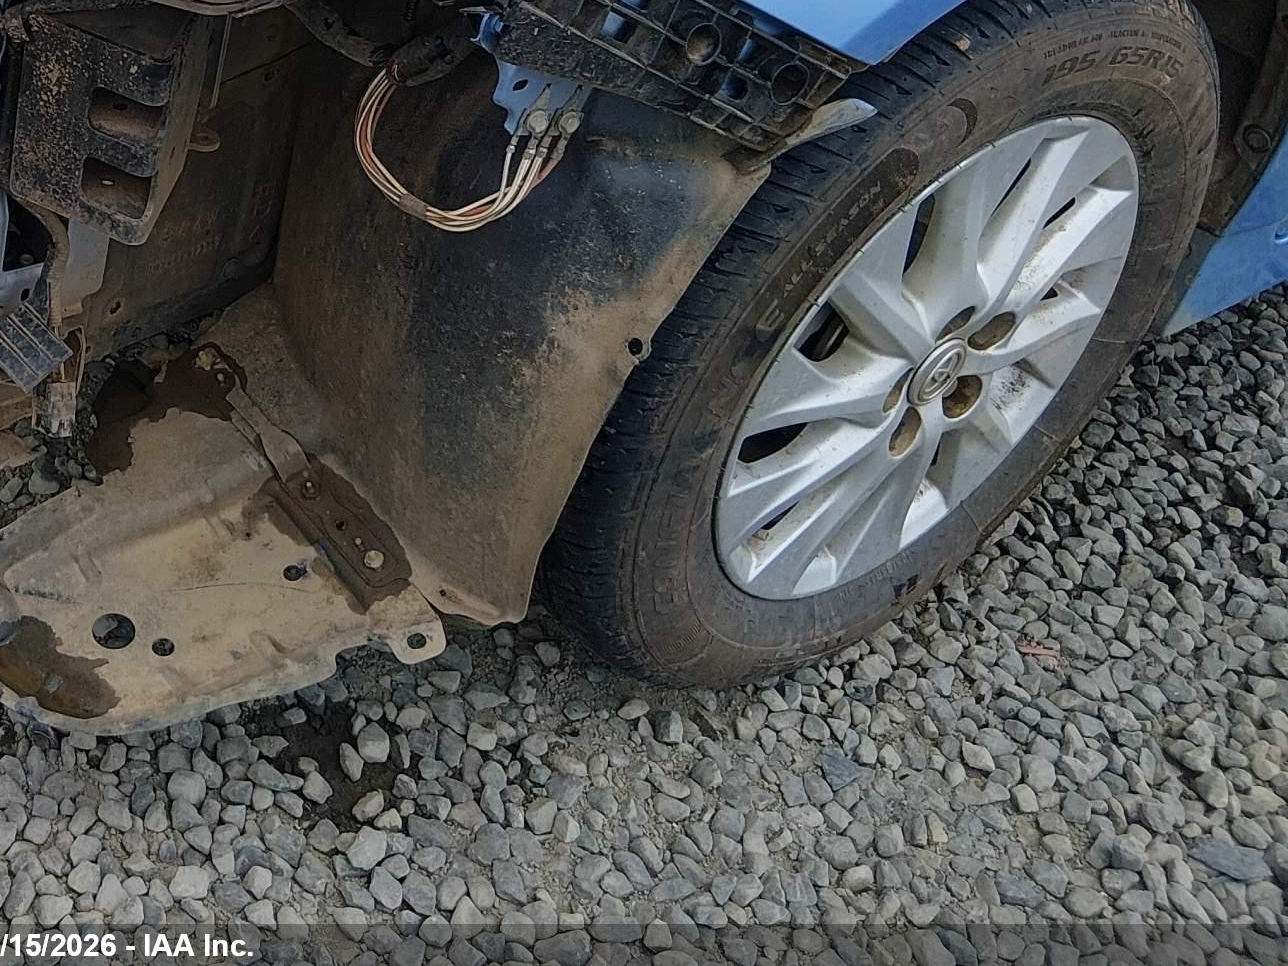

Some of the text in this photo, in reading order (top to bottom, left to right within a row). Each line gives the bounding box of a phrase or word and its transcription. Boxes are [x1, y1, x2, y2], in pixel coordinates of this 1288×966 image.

[1041, 45, 1185, 87] 195/65R15
[783, 259, 813, 298] ALL
[815, 181, 881, 256] SEASON
